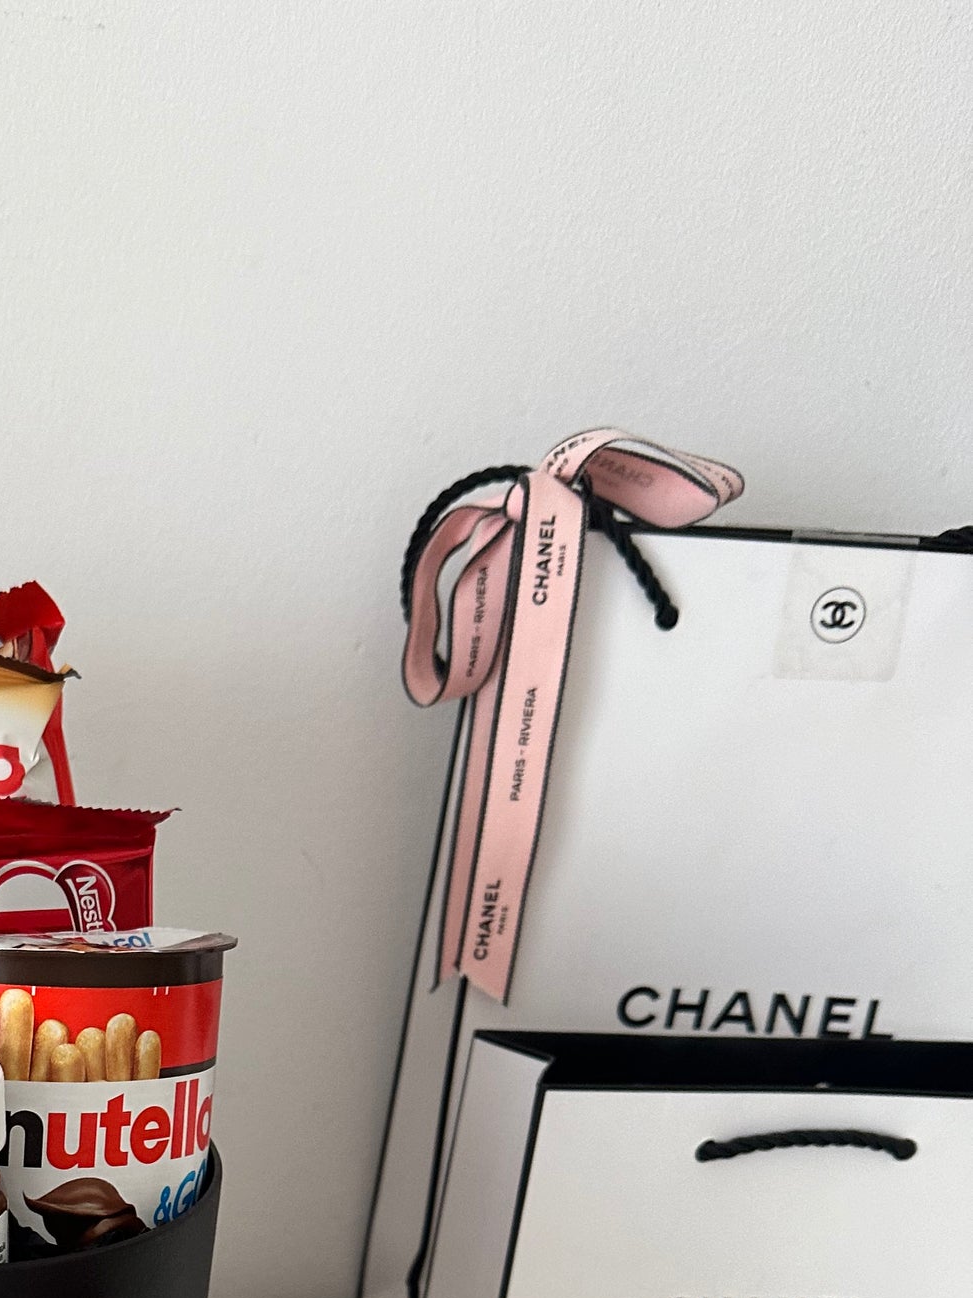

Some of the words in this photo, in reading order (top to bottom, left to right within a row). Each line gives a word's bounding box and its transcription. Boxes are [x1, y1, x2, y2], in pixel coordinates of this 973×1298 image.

[532, 515, 556, 605] CHANEL
[466, 635, 480, 678] PARIS
[474, 566, 488, 624] RIVIERA
[510, 757, 526, 801] PARIS
[518, 687, 538, 747] RIVIERA
[473, 879, 502, 961] CHANEL
[616, 986, 893, 1040] CHANEL
